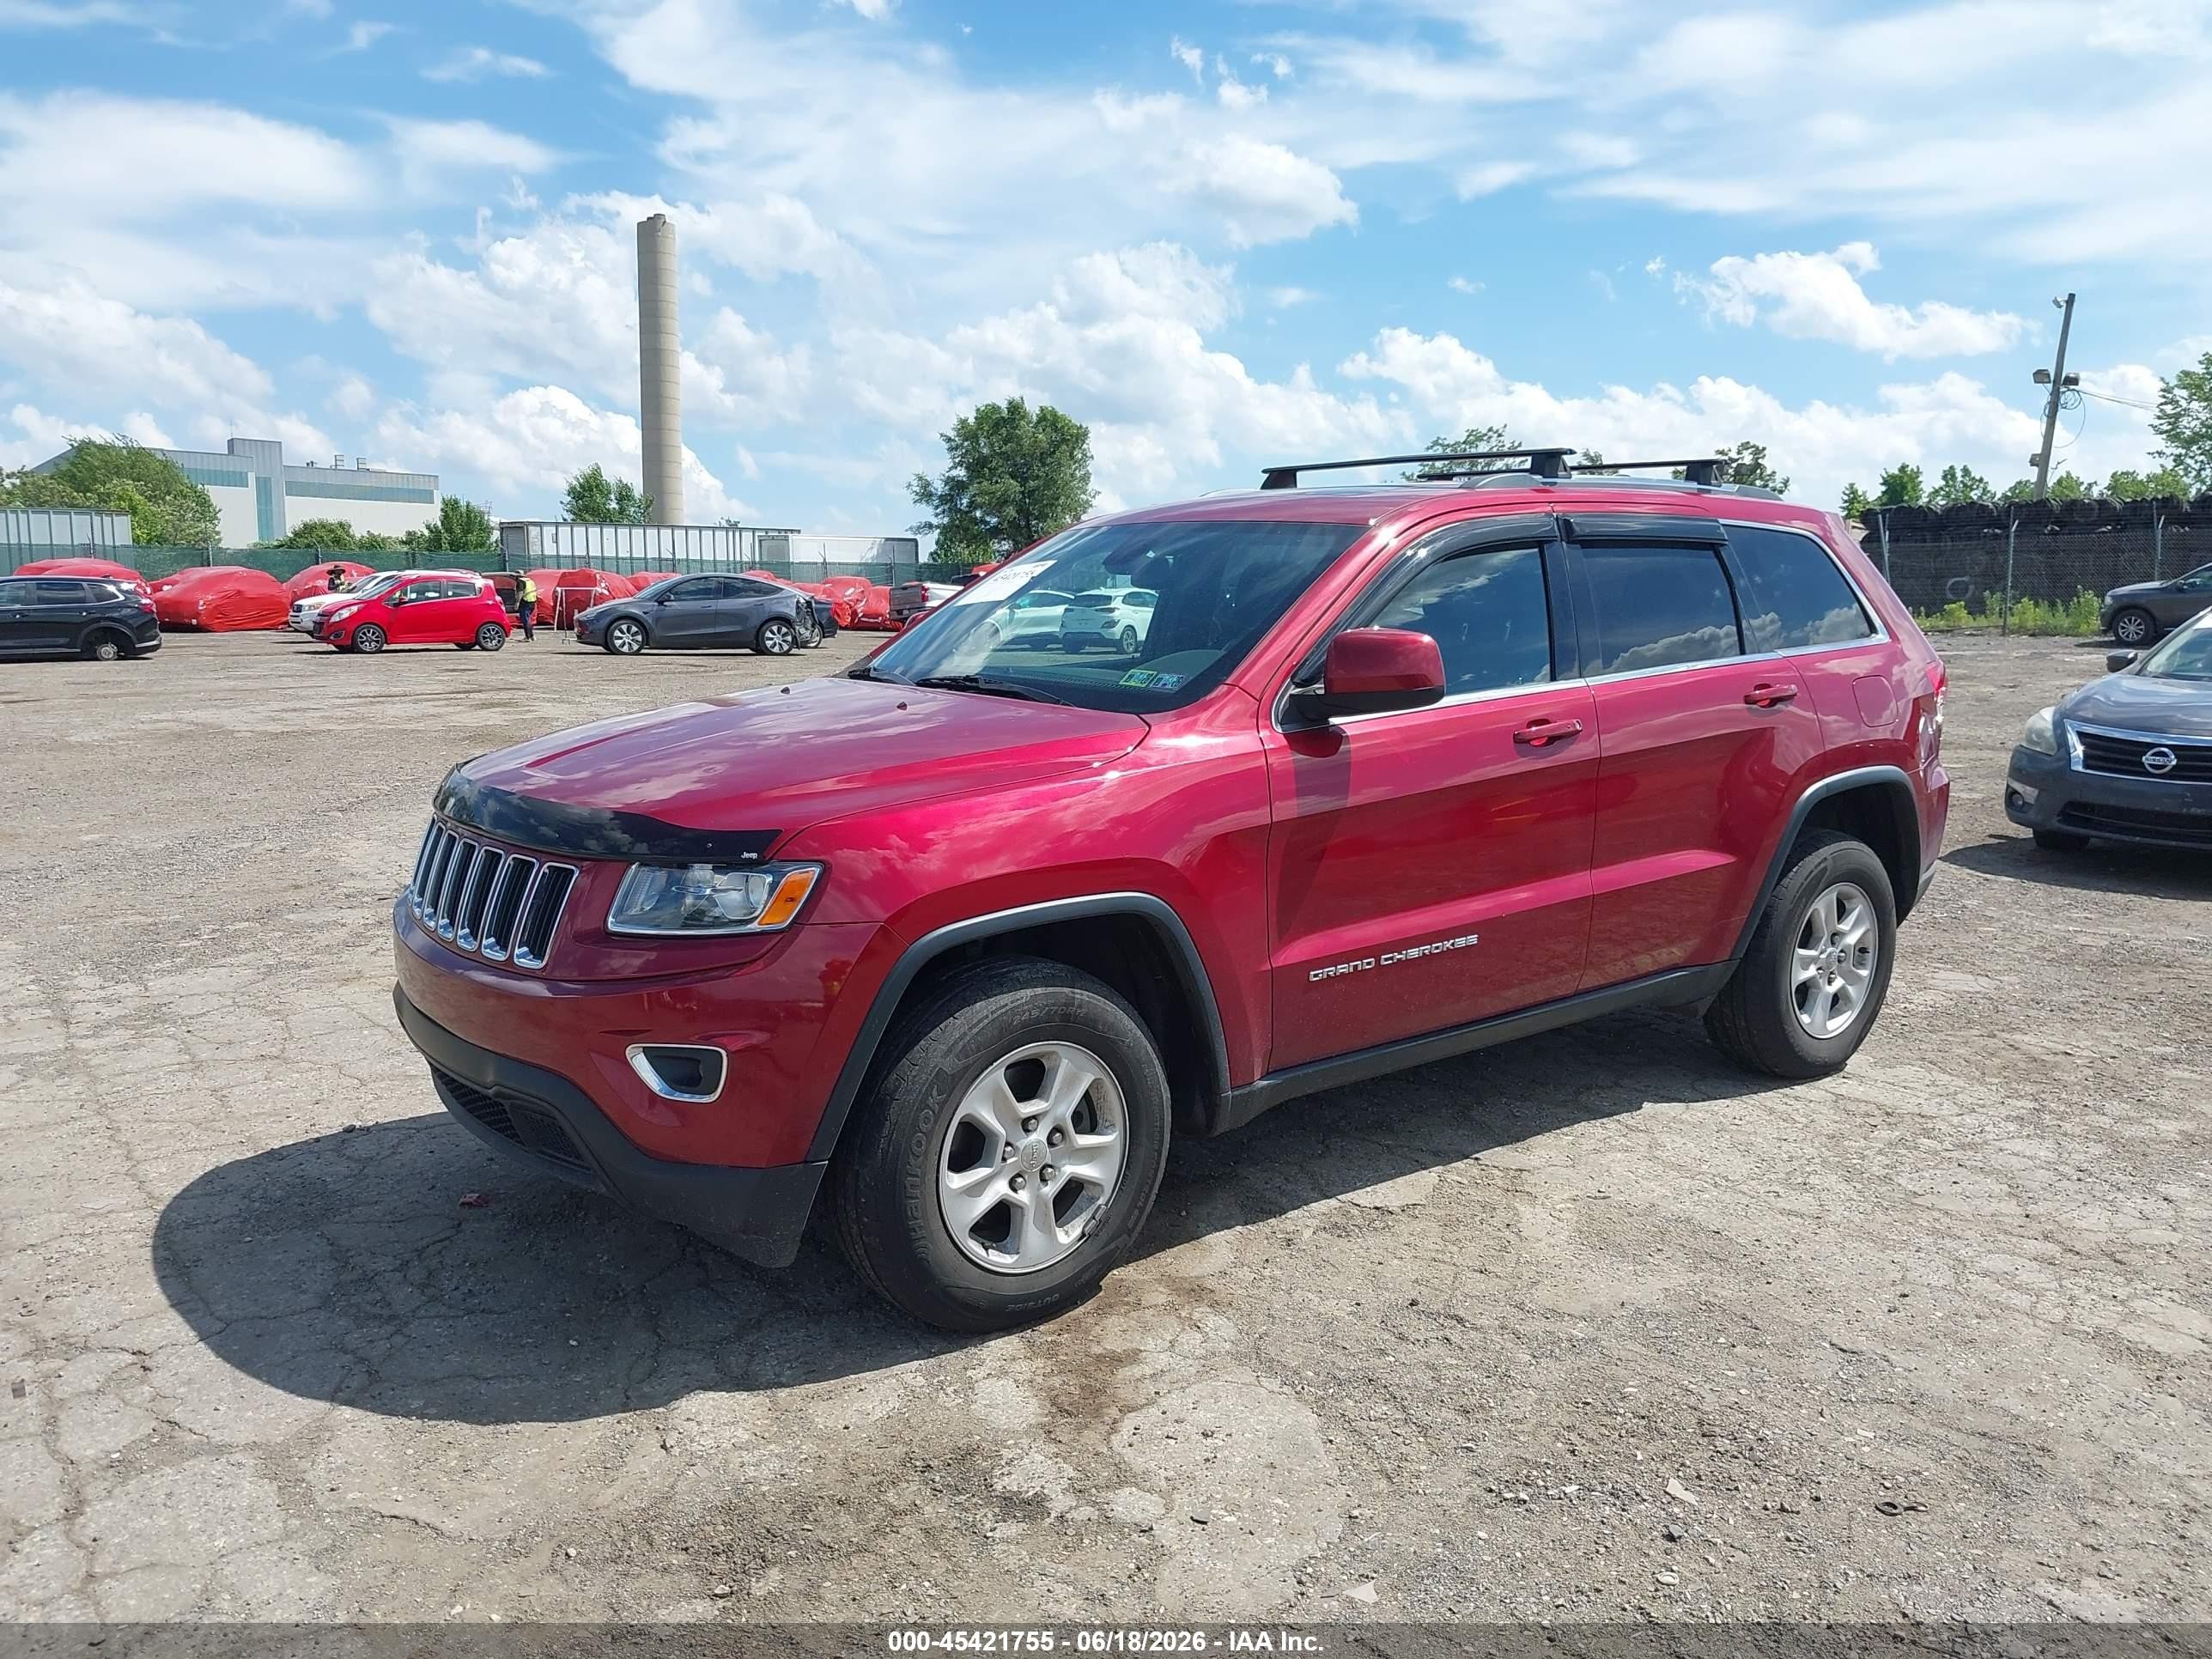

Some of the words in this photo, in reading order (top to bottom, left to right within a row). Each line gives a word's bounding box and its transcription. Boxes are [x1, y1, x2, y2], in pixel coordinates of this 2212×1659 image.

[2144, 756, 2172, 765] NISSAN
[1309, 958, 1375, 981] GRAND
[1380, 935, 1479, 966] CHEROKEE
